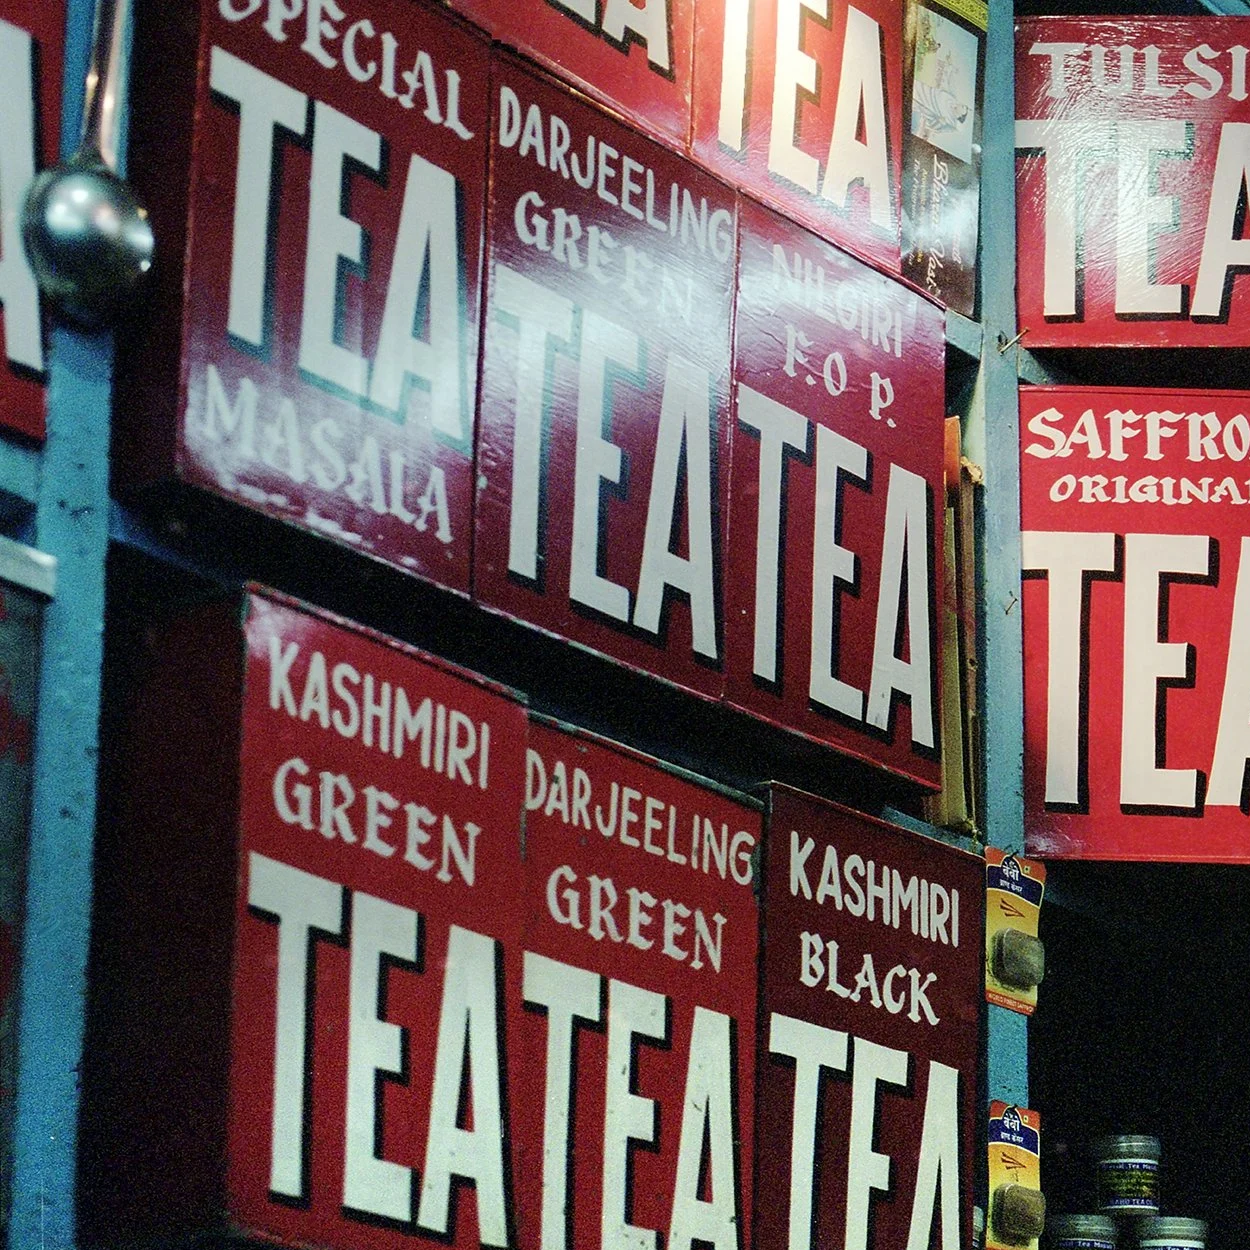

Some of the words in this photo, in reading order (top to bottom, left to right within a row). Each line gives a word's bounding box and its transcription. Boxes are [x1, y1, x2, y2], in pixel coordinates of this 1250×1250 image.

[1029, 41, 1248, 101] TULSI
[499, 86, 732, 264] DARJEELING
[209, 46, 469, 445] TEA
[514, 191, 694, 325] GREEN
[771, 242, 903, 358] NILGIRI
[204, 365, 454, 543] MASALA
[493, 262, 720, 660] TEA
[738, 384, 934, 748] TEA
[268, 635, 490, 789] KASHMIRI
[272, 757, 481, 887] GREEN
[525, 748, 755, 887] DARJEELING
[546, 864, 726, 973] GREEN
[789, 830, 960, 948] KASHMIRI
[799, 931, 940, 1026] BLACK
[247, 852, 512, 1250] TEA
